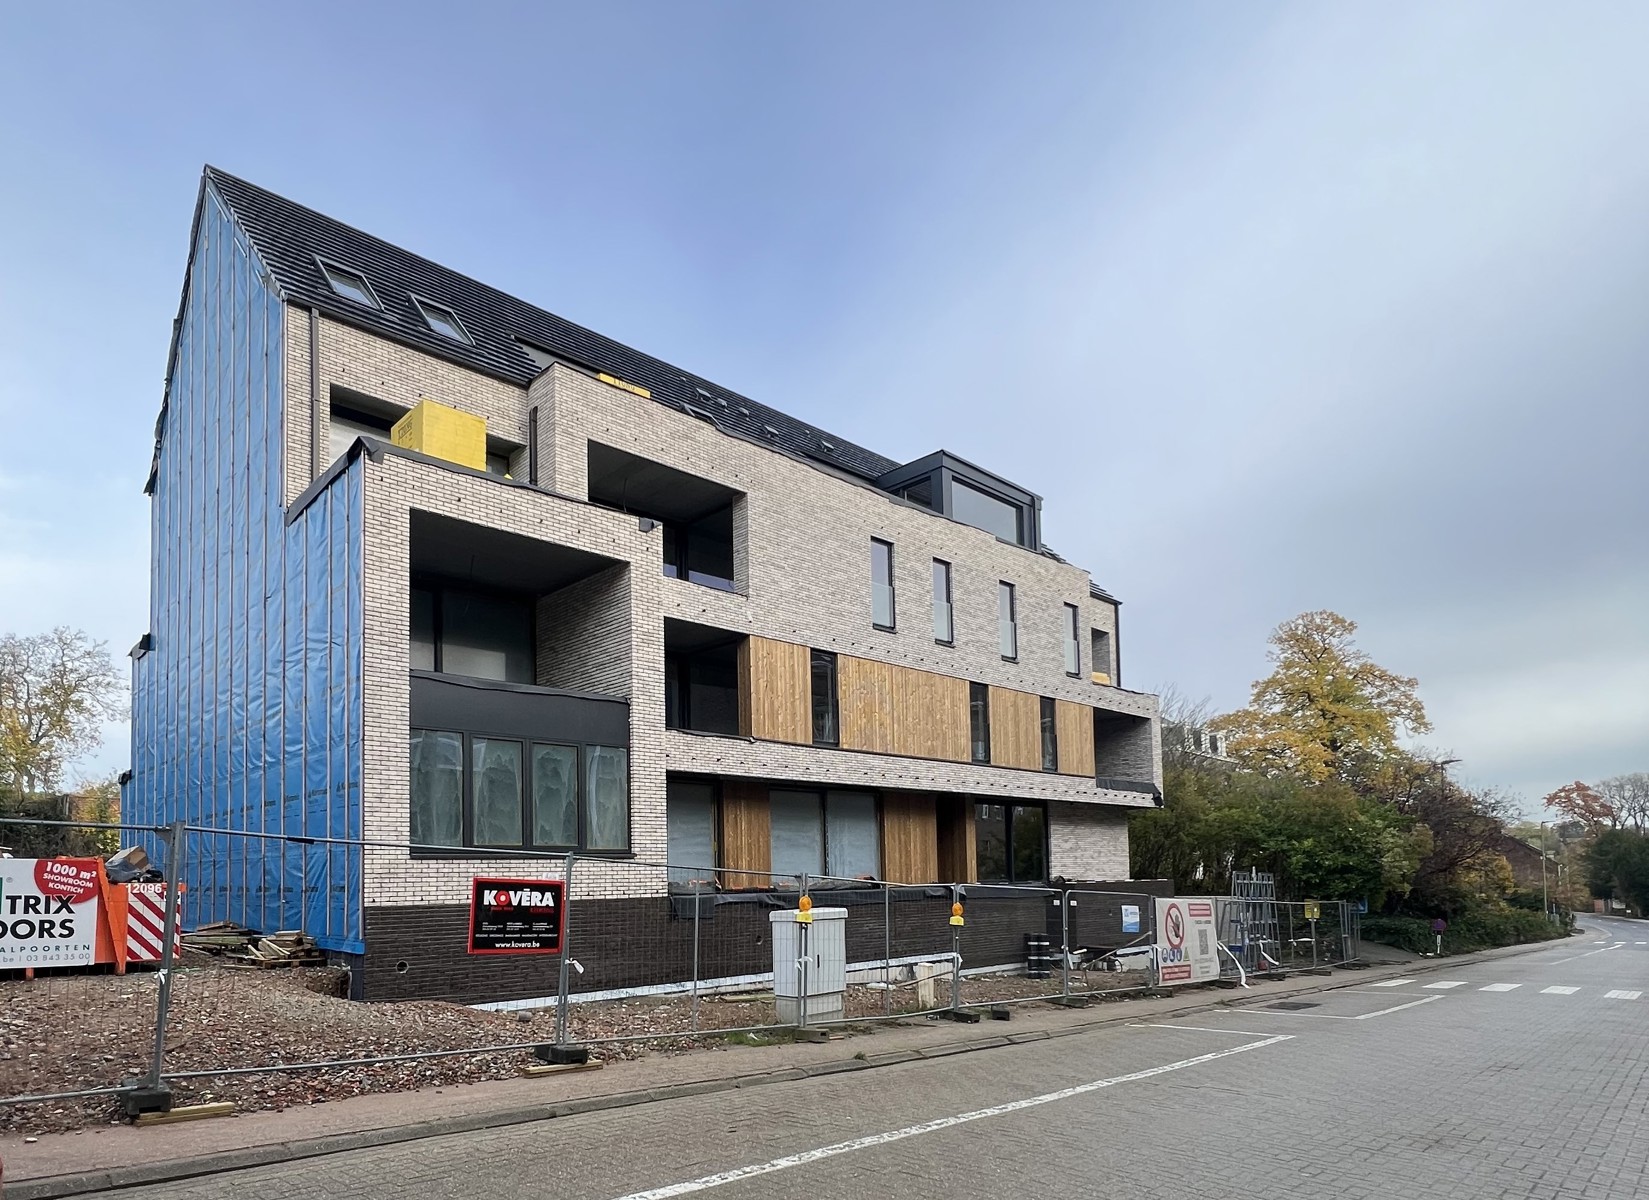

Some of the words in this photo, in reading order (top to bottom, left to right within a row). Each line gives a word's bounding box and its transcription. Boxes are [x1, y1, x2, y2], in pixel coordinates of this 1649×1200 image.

[46, 861, 77, 876] 1000
[42, 872, 94, 888] SHOWROOM
[48, 881, 84, 894] KONTICH
[126, 883, 162, 894] 12096
[5, 894, 76, 915] TRIX
[494, 940, 541, 948] www.kovera.be
[26, 954, 38, 962] 03
